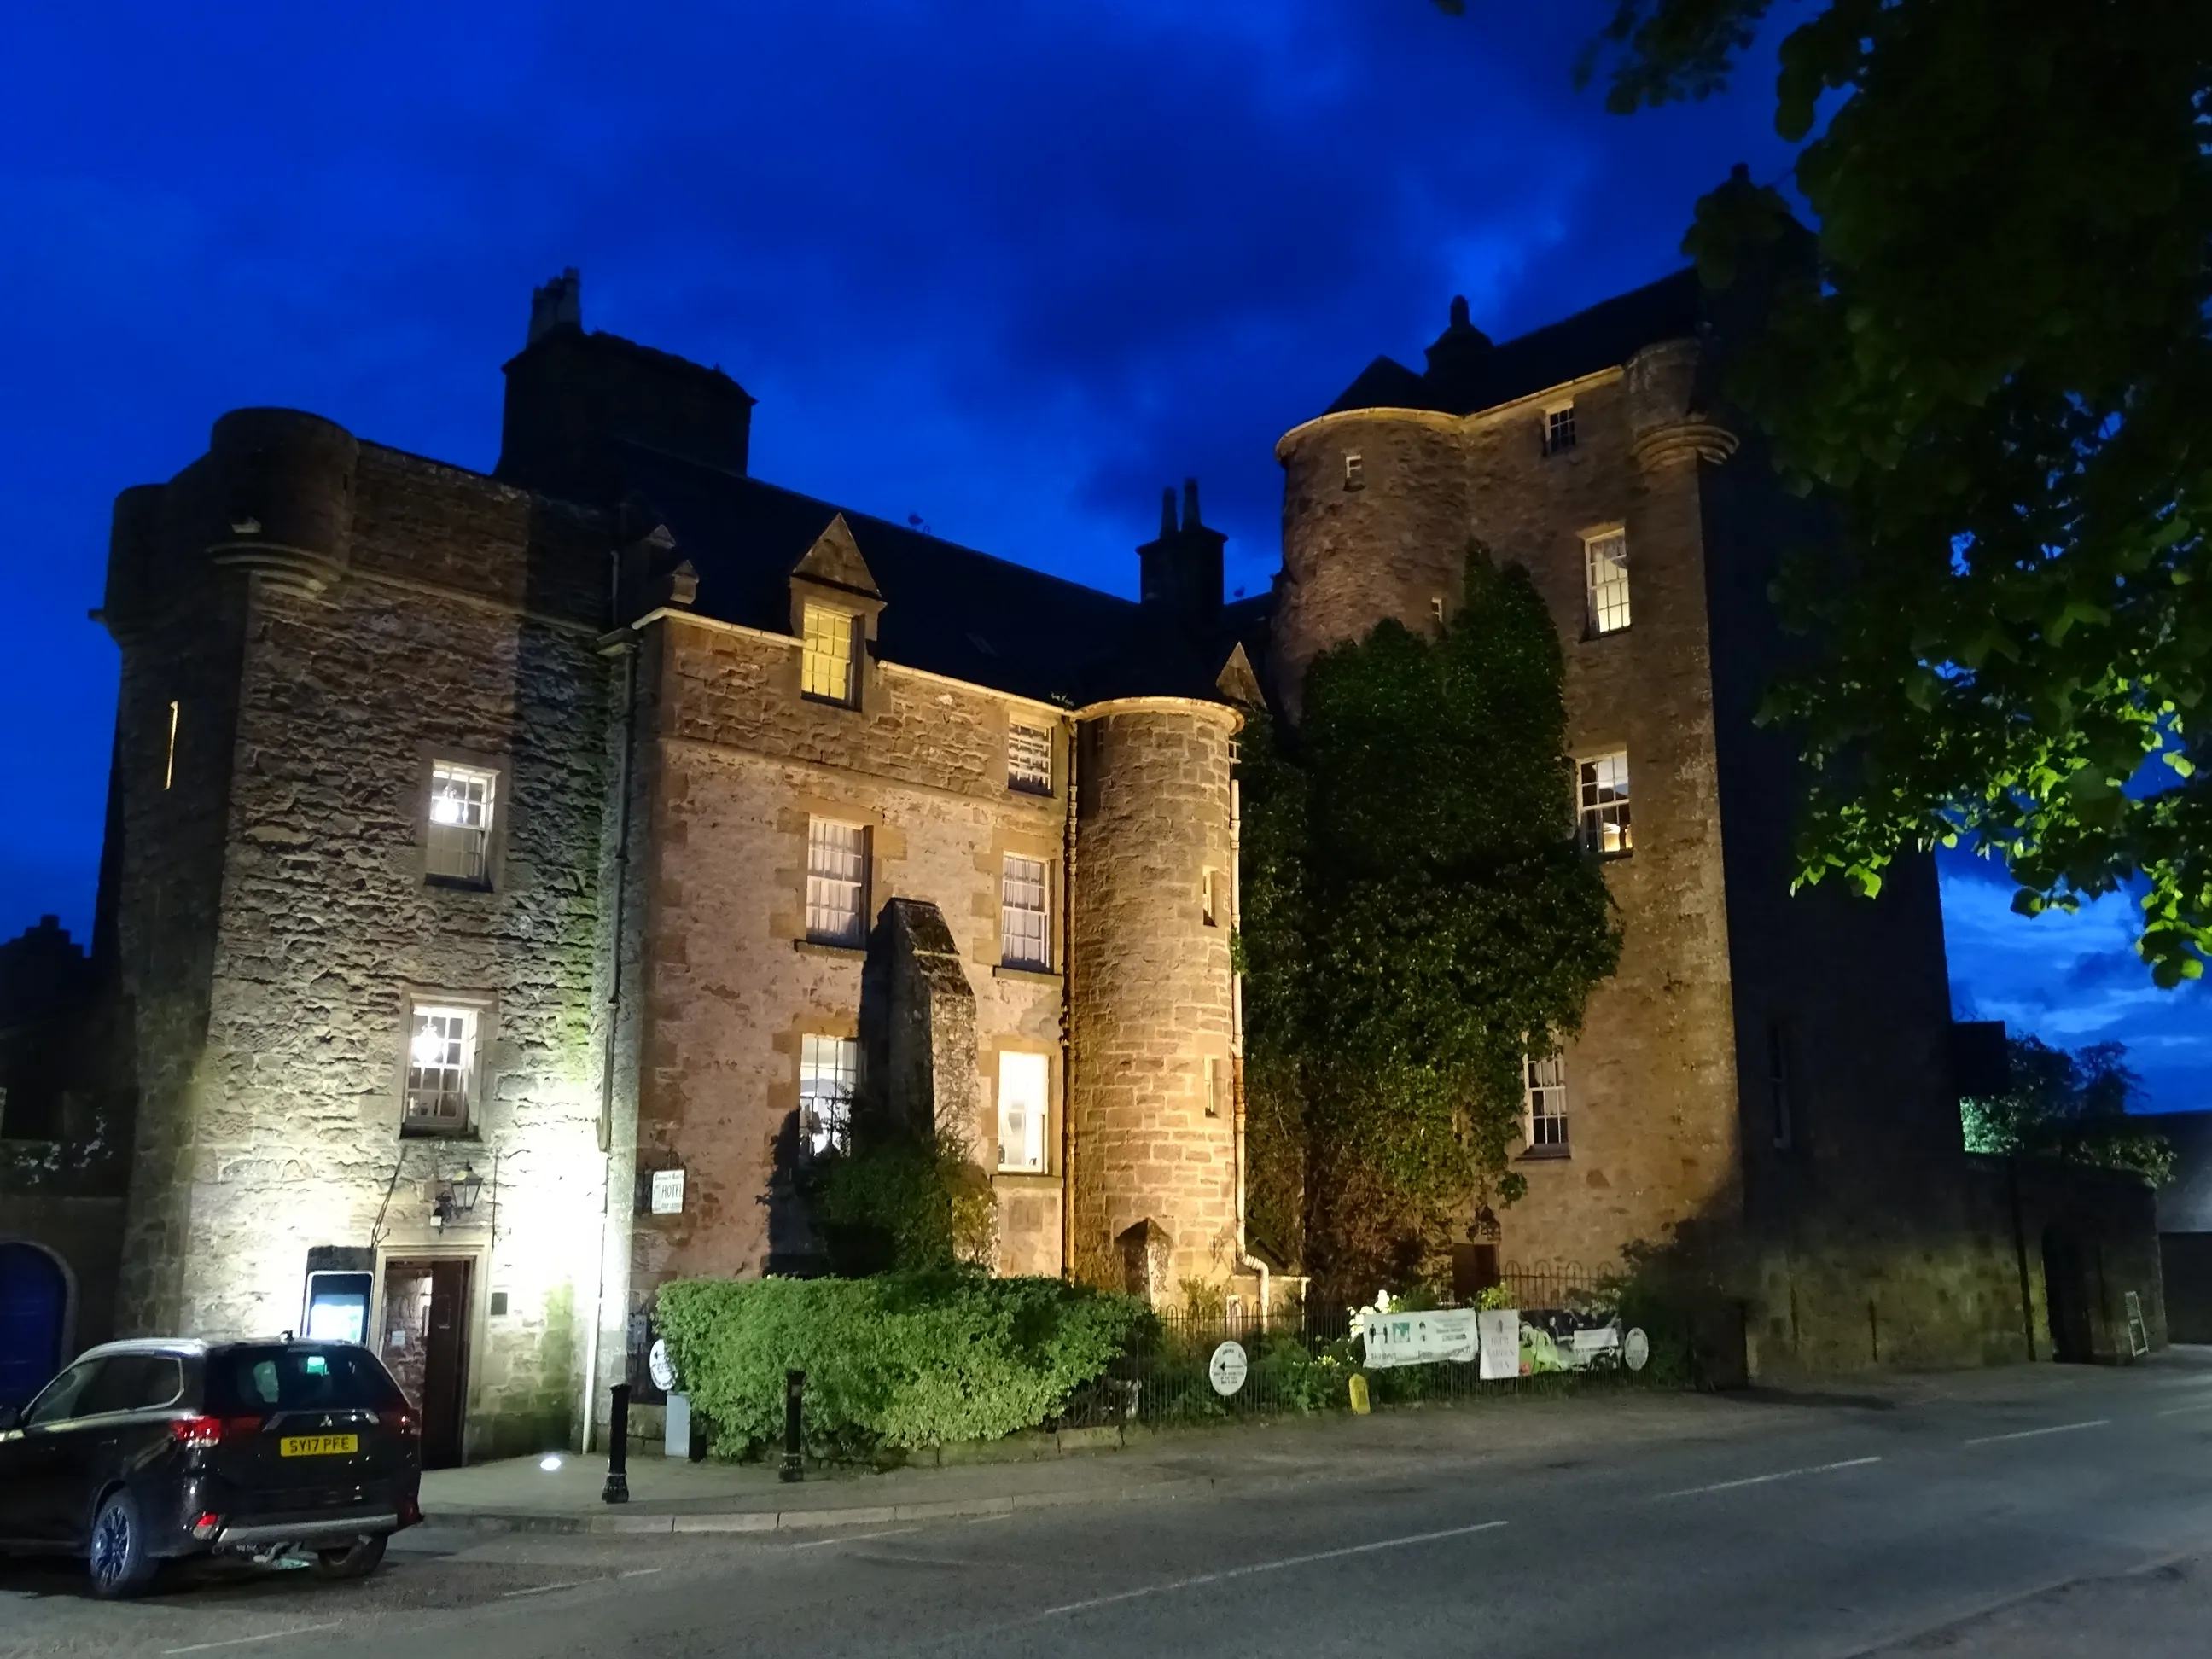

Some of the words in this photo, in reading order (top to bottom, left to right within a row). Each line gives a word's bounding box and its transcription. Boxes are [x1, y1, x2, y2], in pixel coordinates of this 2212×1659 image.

[661, 1183, 683, 1198] HOTEL
[290, 1438, 319, 1453] SY17
[324, 1436, 349, 1452] PFE
